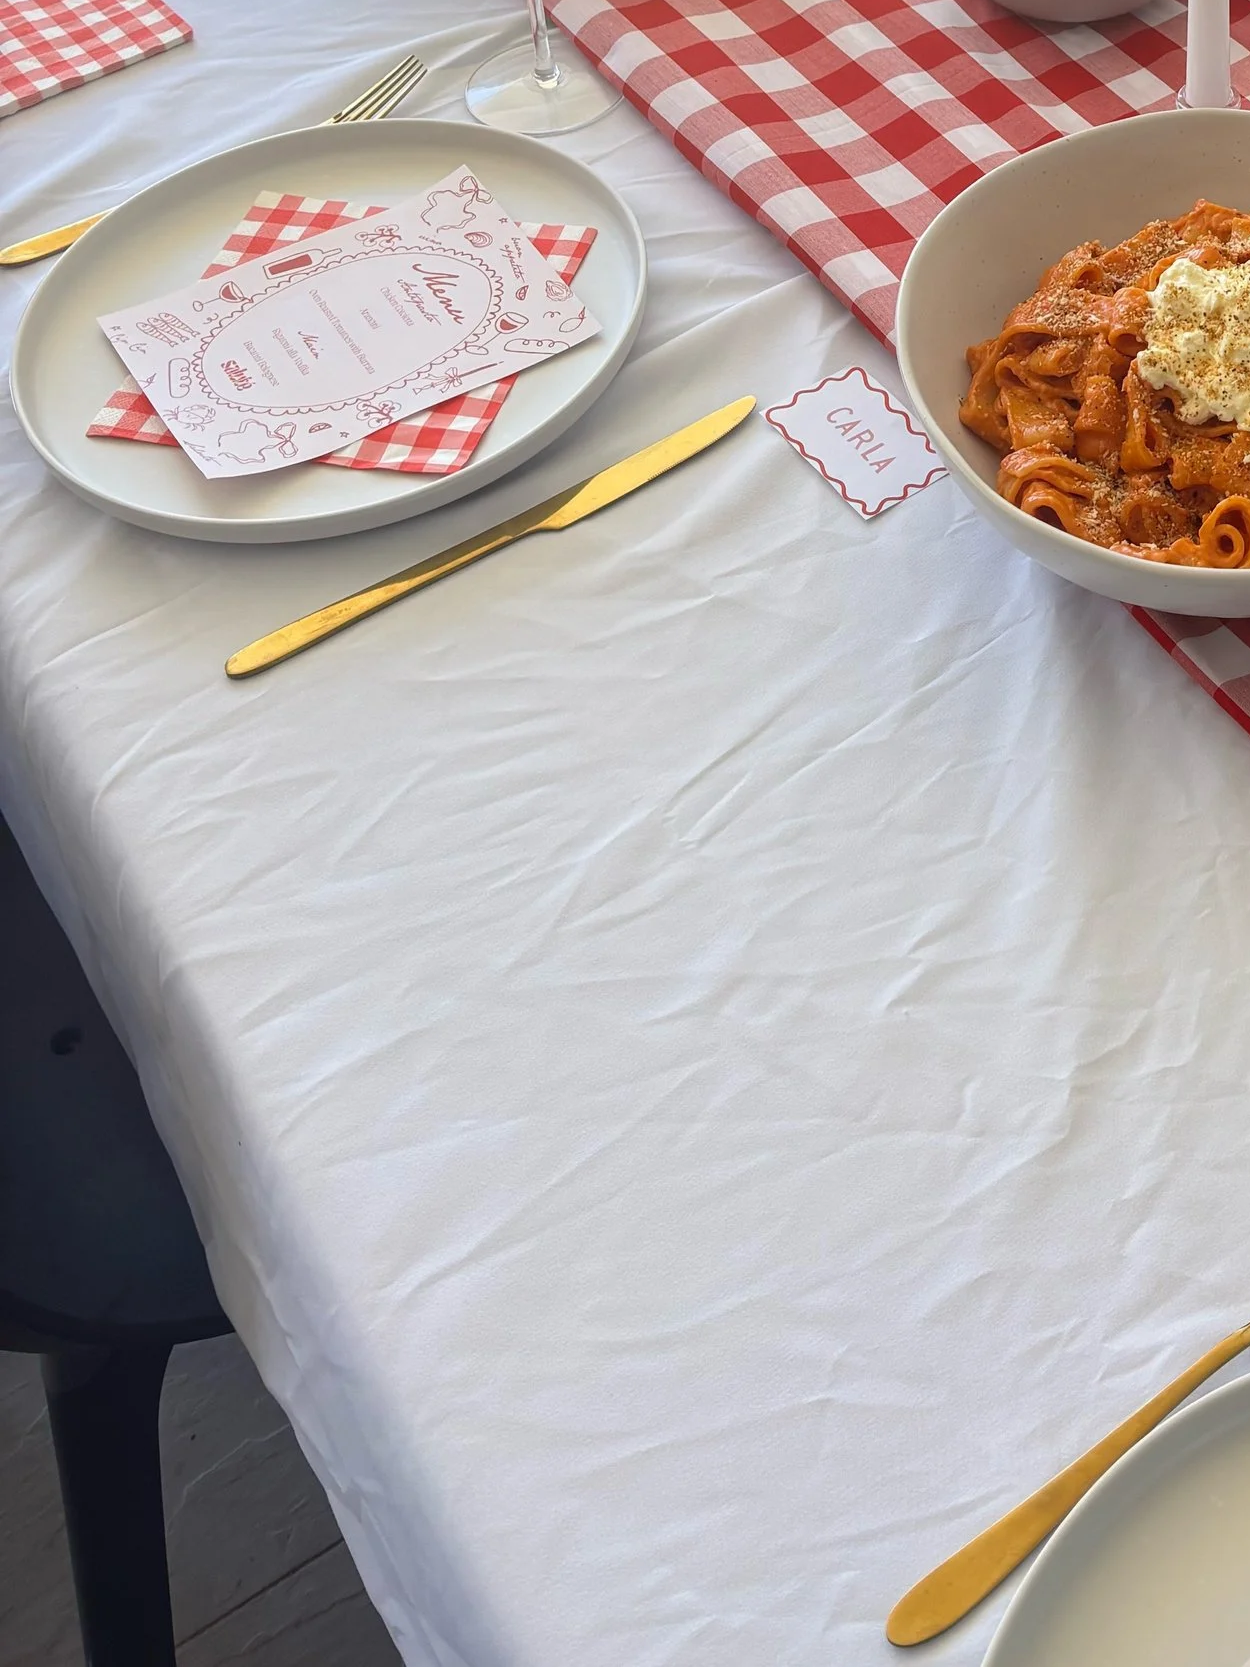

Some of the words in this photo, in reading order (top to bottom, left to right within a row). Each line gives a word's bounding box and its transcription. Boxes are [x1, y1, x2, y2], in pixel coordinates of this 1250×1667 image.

[412, 263, 465, 325] Menu
[298, 330, 324, 360] Main
[826, 406, 897, 475] CARLA
